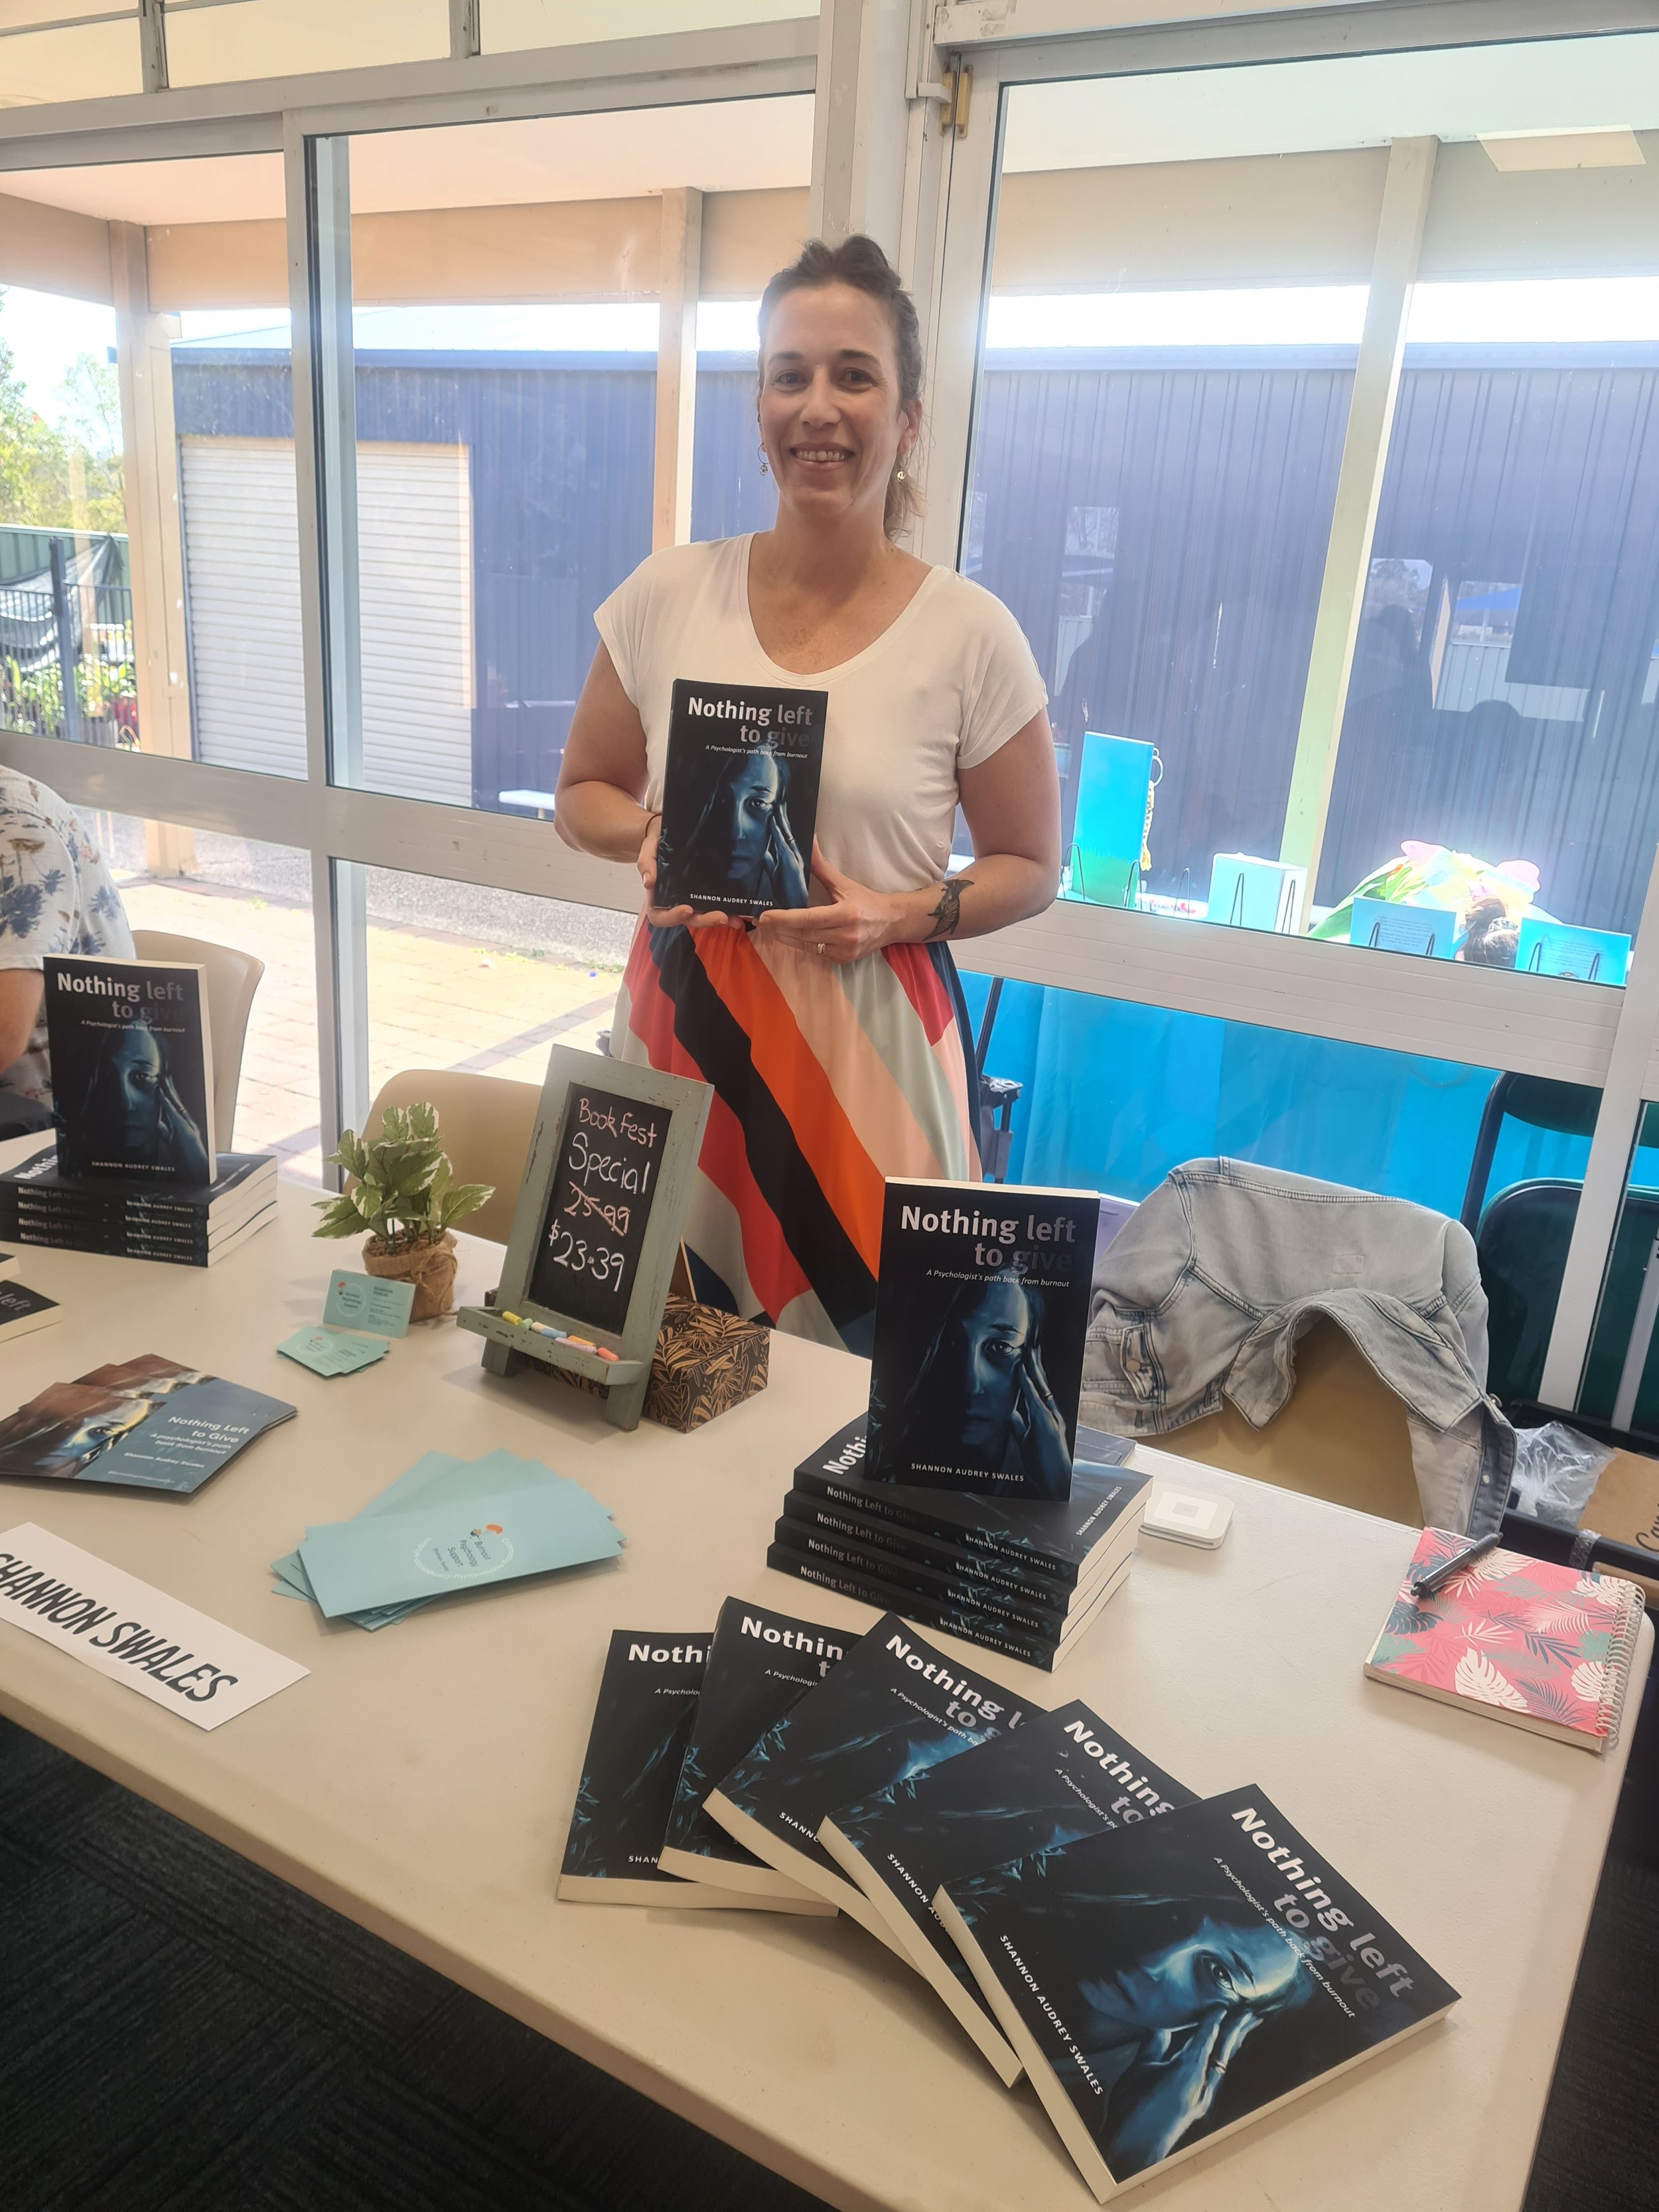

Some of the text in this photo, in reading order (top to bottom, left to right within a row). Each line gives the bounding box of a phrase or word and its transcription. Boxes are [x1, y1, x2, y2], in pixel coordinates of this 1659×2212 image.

[688, 697, 813, 726] Nothing left
[711, 745, 746, 754] Psychologist's
[740, 725, 810, 749] to give
[690, 893, 721, 902] SHANNON
[57, 972, 184, 1003] Nothing left
[111, 1000, 183, 1025] to giv
[579, 1098, 617, 1138] Book
[569, 1132, 650, 1195] Special
[18, 1187, 48, 1198] Nothing
[18, 1201, 47, 1213] Nothing
[19, 1218, 48, 1229] Nothing
[21, 1232, 49, 1244] Nothing
[901, 1205, 1076, 1244] Nothing left
[548, 1218, 625, 1292] $23.39
[975, 1242, 1073, 1275] to give
[934, 1270, 983, 1282] Psychologist's
[984, 1274, 1001, 1283] path
[1003, 1276, 1020, 1284] back
[1021, 1277, 1039, 1286] from
[1041, 1278, 1070, 1288] burnout
[168, 1416, 250, 1435] Nothing Left
[209, 1433, 240, 1443] Give
[822, 1436, 866, 1475] Nothi
[911, 1463, 1025, 1482] SHANNON AUDREY SWALES
[827, 1486, 863, 1508] Nothing
[865, 1499, 882, 1512] Left
[885, 1507, 893, 1516] to
[1076, 1486, 1121, 1536] SHANNON AUDREY SWALES
[817, 1512, 853, 1534] Nothing
[855, 1526, 872, 1538] Left
[875, 1534, 884, 1544] to
[808, 1538, 844, 1561] Nothing
[847, 1552, 863, 1567] Left
[866, 1560, 875, 1570] to
[966, 1533, 1056, 1571] SHANNON AUDREY SWALES
[800, 1565, 837, 1588] Nothing
[839, 1580, 855, 1593] Left
[858, 1587, 867, 1597] to
[956, 1562, 1046, 1600] SHANNON AUDREY SWALES
[948, 1589, 1039, 1628] SHANNON AUDREY SWALES
[741, 1616, 849, 1660] Nothin
[940, 1617, 1031, 1657] SHANNON AUDREY SWALES
[88, 1622, 239, 1702] SWALES
[885, 1635, 1005, 1721] Nothing
[898, 1692, 947, 1728] Psychologist's
[948, 1725, 967, 1739] path
[946, 1700, 977, 1728] to
[1062, 1775, 1109, 1821] Psychologist's
[1111, 1796, 1144, 1824] to
[887, 1854, 929, 1903] SHANNON
[1231, 1807, 1414, 1998] Nothing left
[1220, 1864, 1269, 1918] Psychologist's
[1265, 1917, 1286, 1937] path
[1285, 1938, 1305, 1958] back
[1301, 1958, 1324, 1980] from
[1322, 1982, 1355, 2018] burnout
[1273, 1893, 1380, 2009] to give
[1000, 1935, 1104, 2095] SHANNON AUDREY SWALES
